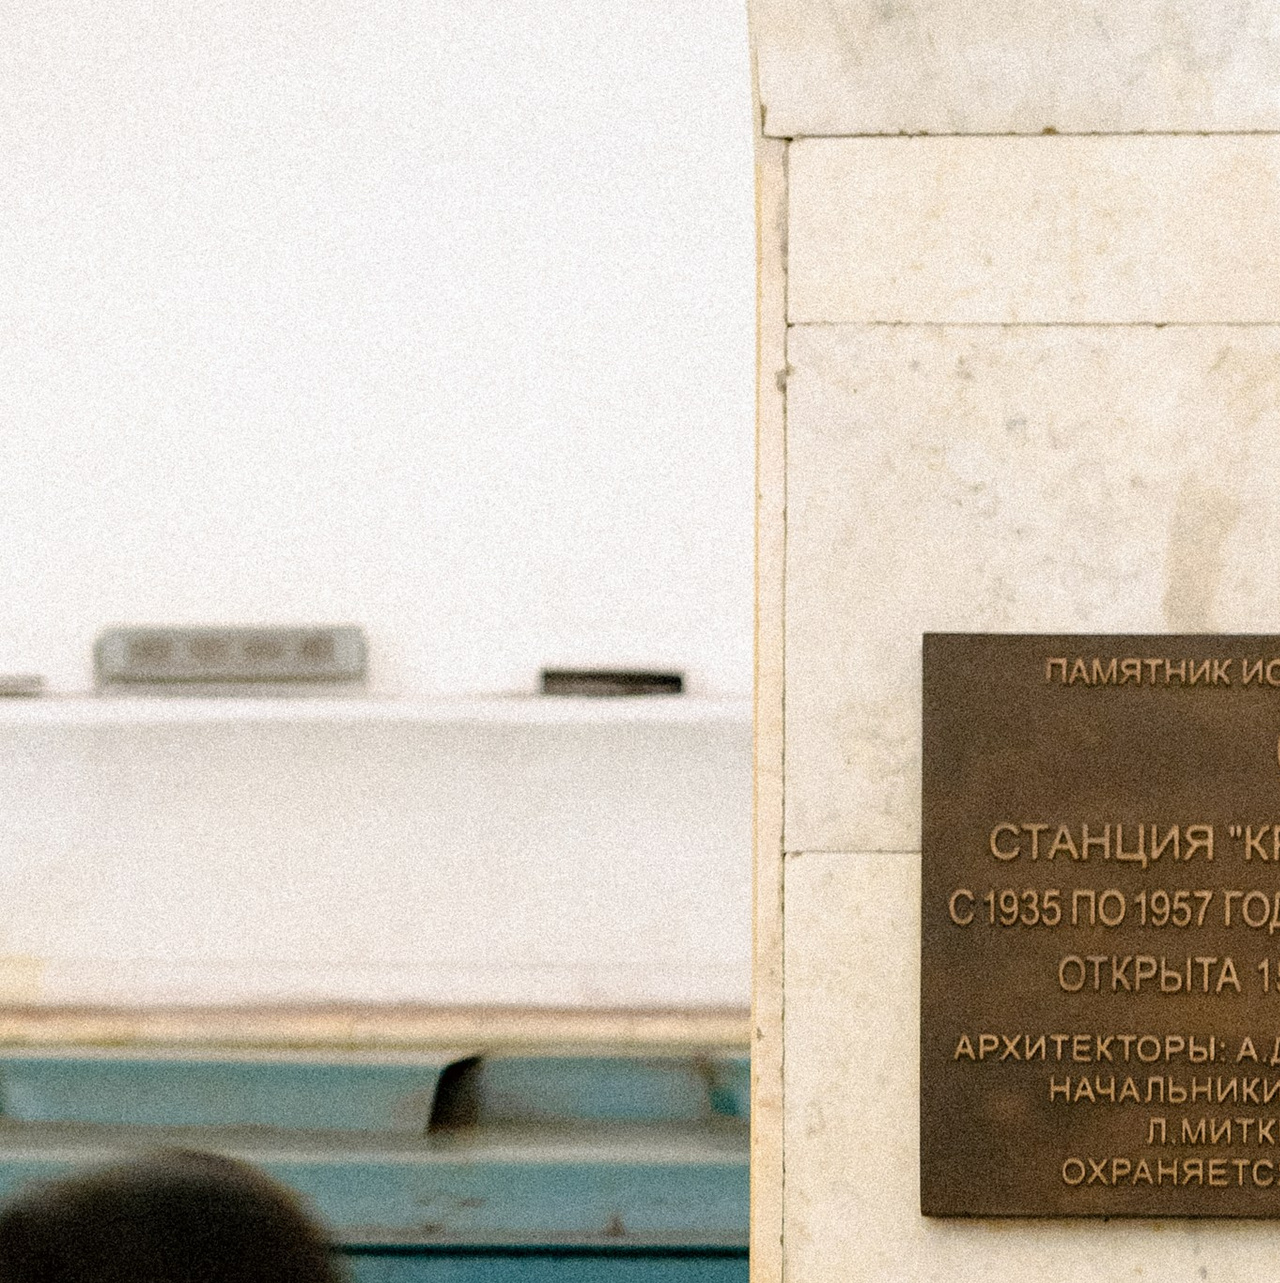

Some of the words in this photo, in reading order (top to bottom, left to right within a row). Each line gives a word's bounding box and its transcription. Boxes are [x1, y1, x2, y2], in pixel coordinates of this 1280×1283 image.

[1045, 658, 1231, 685] ПАМЯТНИК
[989, 822, 1214, 868] СТАНЦИЯ
[949, 887, 974, 925] С
[985, 888, 1062, 926] 1935
[1071, 888, 1126, 926] ПО
[1135, 889, 1213, 926] 1957
[1058, 954, 1241, 992] ОТКРЫТА
[954, 1033, 1225, 1062] АРХИТЕКТОРЫ:
